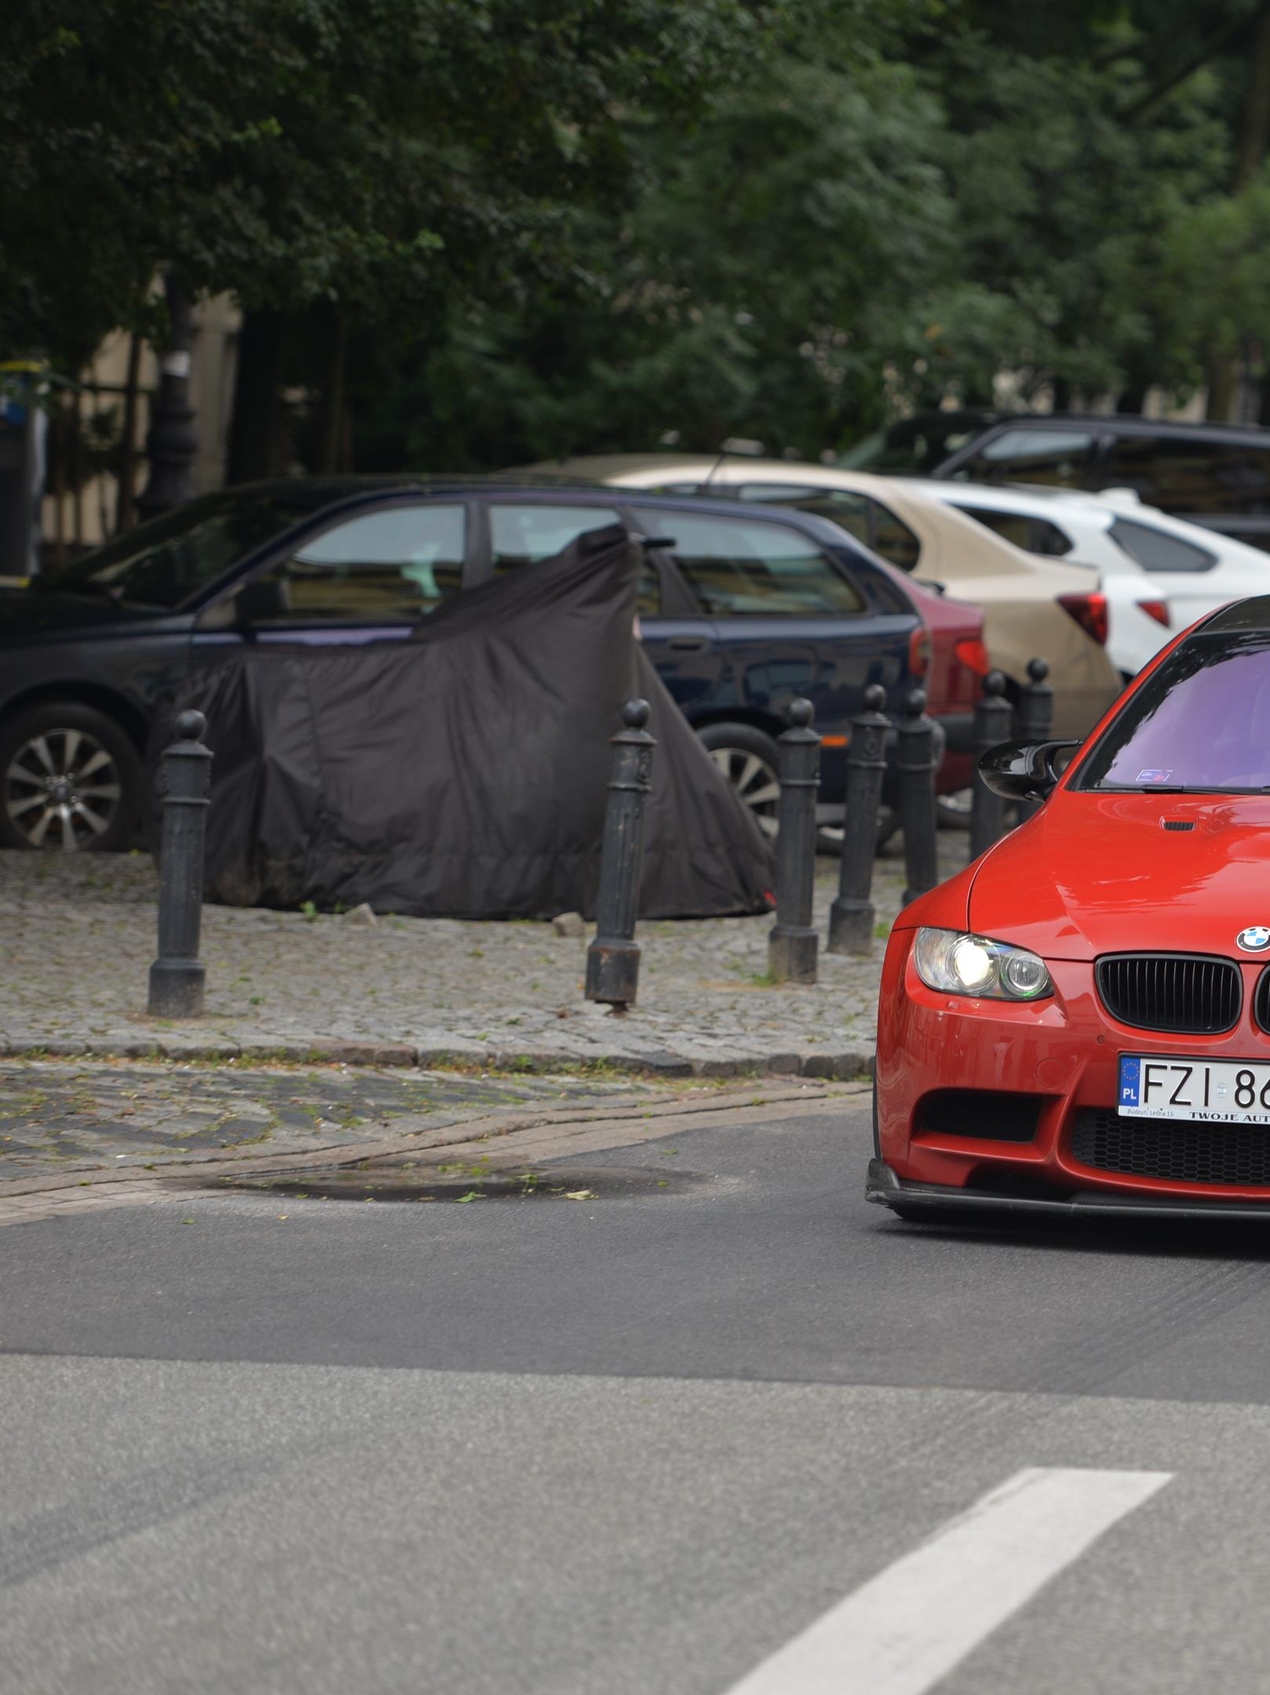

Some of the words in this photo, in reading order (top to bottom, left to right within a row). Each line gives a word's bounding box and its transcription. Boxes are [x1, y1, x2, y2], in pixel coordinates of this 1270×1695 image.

[1144, 1064, 1210, 1107] FZI
[1122, 1088, 1137, 1100] PL
[1189, 1111, 1239, 1122] TWOJE
